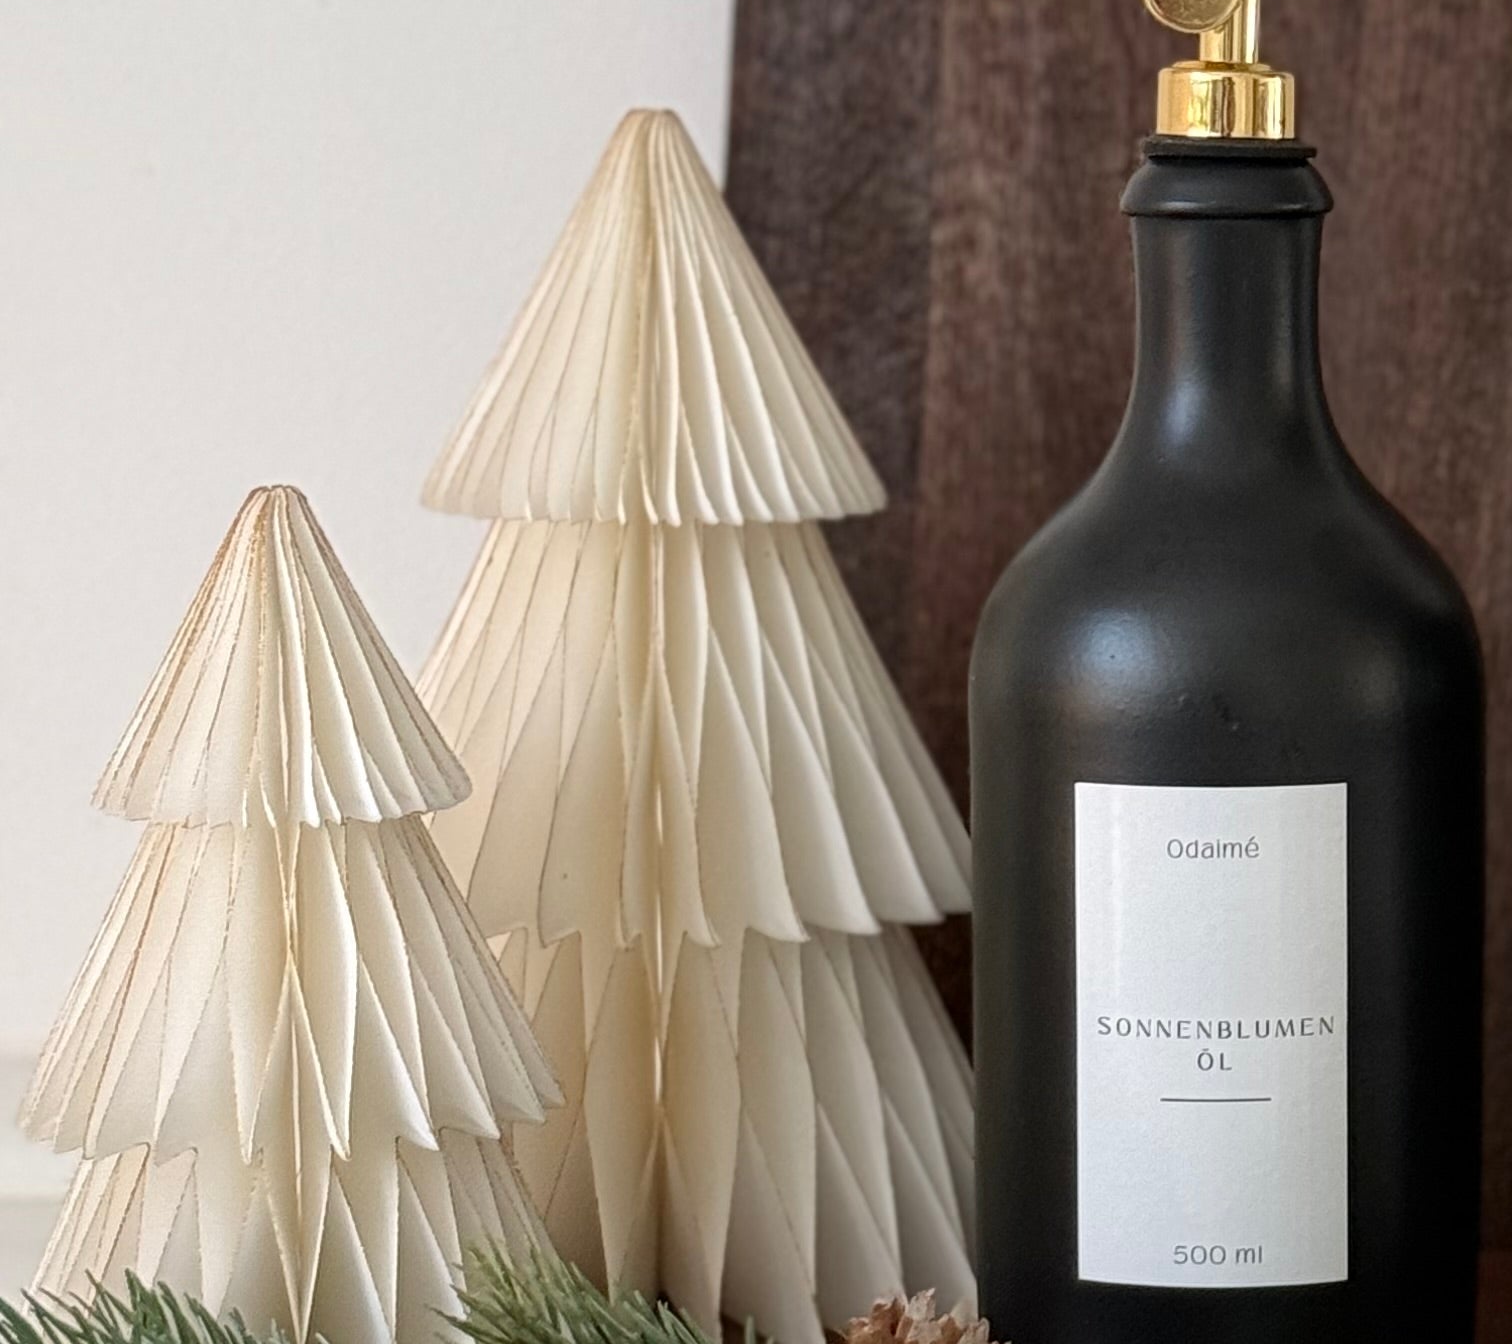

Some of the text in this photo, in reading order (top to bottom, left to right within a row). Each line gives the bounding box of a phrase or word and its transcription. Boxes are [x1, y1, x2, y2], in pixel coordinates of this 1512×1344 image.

[1166, 835, 1260, 860] Odaimé
[1097, 1015, 1335, 1040] SONNENBLUMEN
[1196, 1047, 1233, 1072] ÖL
[1173, 1245, 1263, 1266] 500 ml
